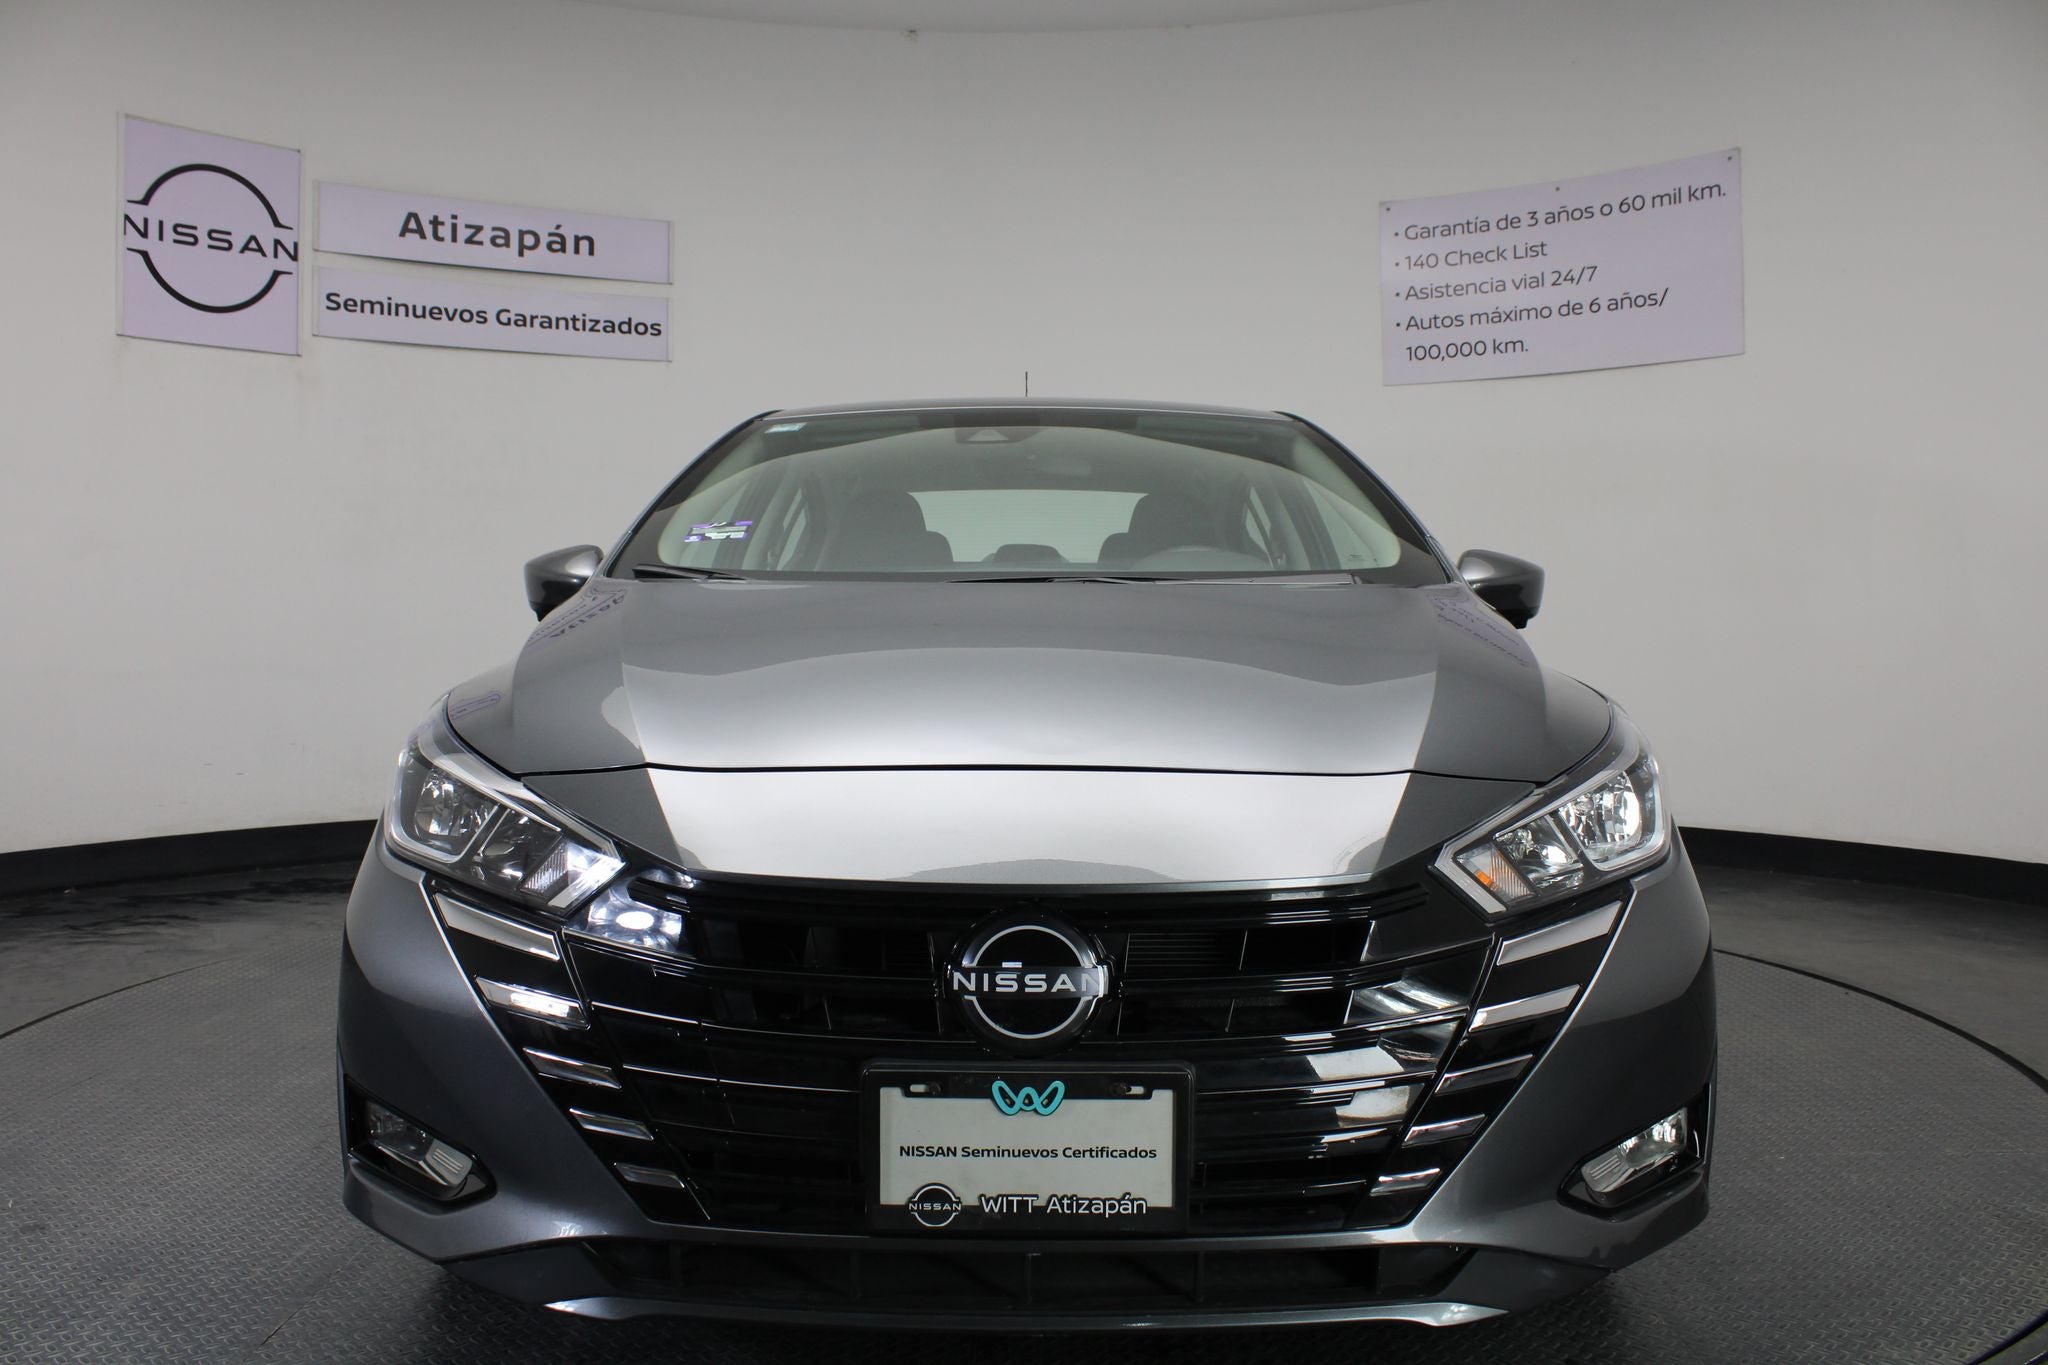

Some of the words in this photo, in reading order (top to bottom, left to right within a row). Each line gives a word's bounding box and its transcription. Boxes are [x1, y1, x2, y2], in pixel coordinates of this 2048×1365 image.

[1405, 216, 1490, 240] Garantía
[1497, 212, 1521, 230] de
[1528, 211, 1538, 227] 3
[1544, 204, 1594, 225] años
[1600, 203, 1612, 217] o
[1619, 195, 1645, 213] 60
[1652, 187, 1682, 208] mil
[1688, 181, 1726, 202] km.
[123, 213, 299, 262] NISSAN
[399, 211, 596, 257] Atizapán
[1405, 253, 1438, 270] 140
[1445, 246, 1507, 267] Check
[1513, 241, 1547, 259] List
[1405, 278, 1506, 301] Asistencia
[1512, 272, 1545, 290] vial
[1551, 265, 1598, 286] 24/7
[325, 292, 488, 326] Seminuevos
[496, 308, 662, 338] Garantizados
[1406, 312, 1464, 331] Autos
[1470, 304, 1552, 326] máximo
[1558, 299, 1583, 318] de
[1589, 298, 1600, 313] 6
[1608, 288, 1669, 312] años/
[1406, 341, 1487, 362] 100,000
[1493, 338, 1528, 355] km.
[953, 971, 1105, 993] NISSAN
[899, 1146, 957, 1158] NISSAN
[961, 1146, 1058, 1159] Seminuevos
[1062, 1146, 1157, 1159] Certificados
[909, 1202, 961, 1211] NISSAN
[980, 1196, 1038, 1214] WITT
[1047, 1195, 1146, 1218] Atizapán
